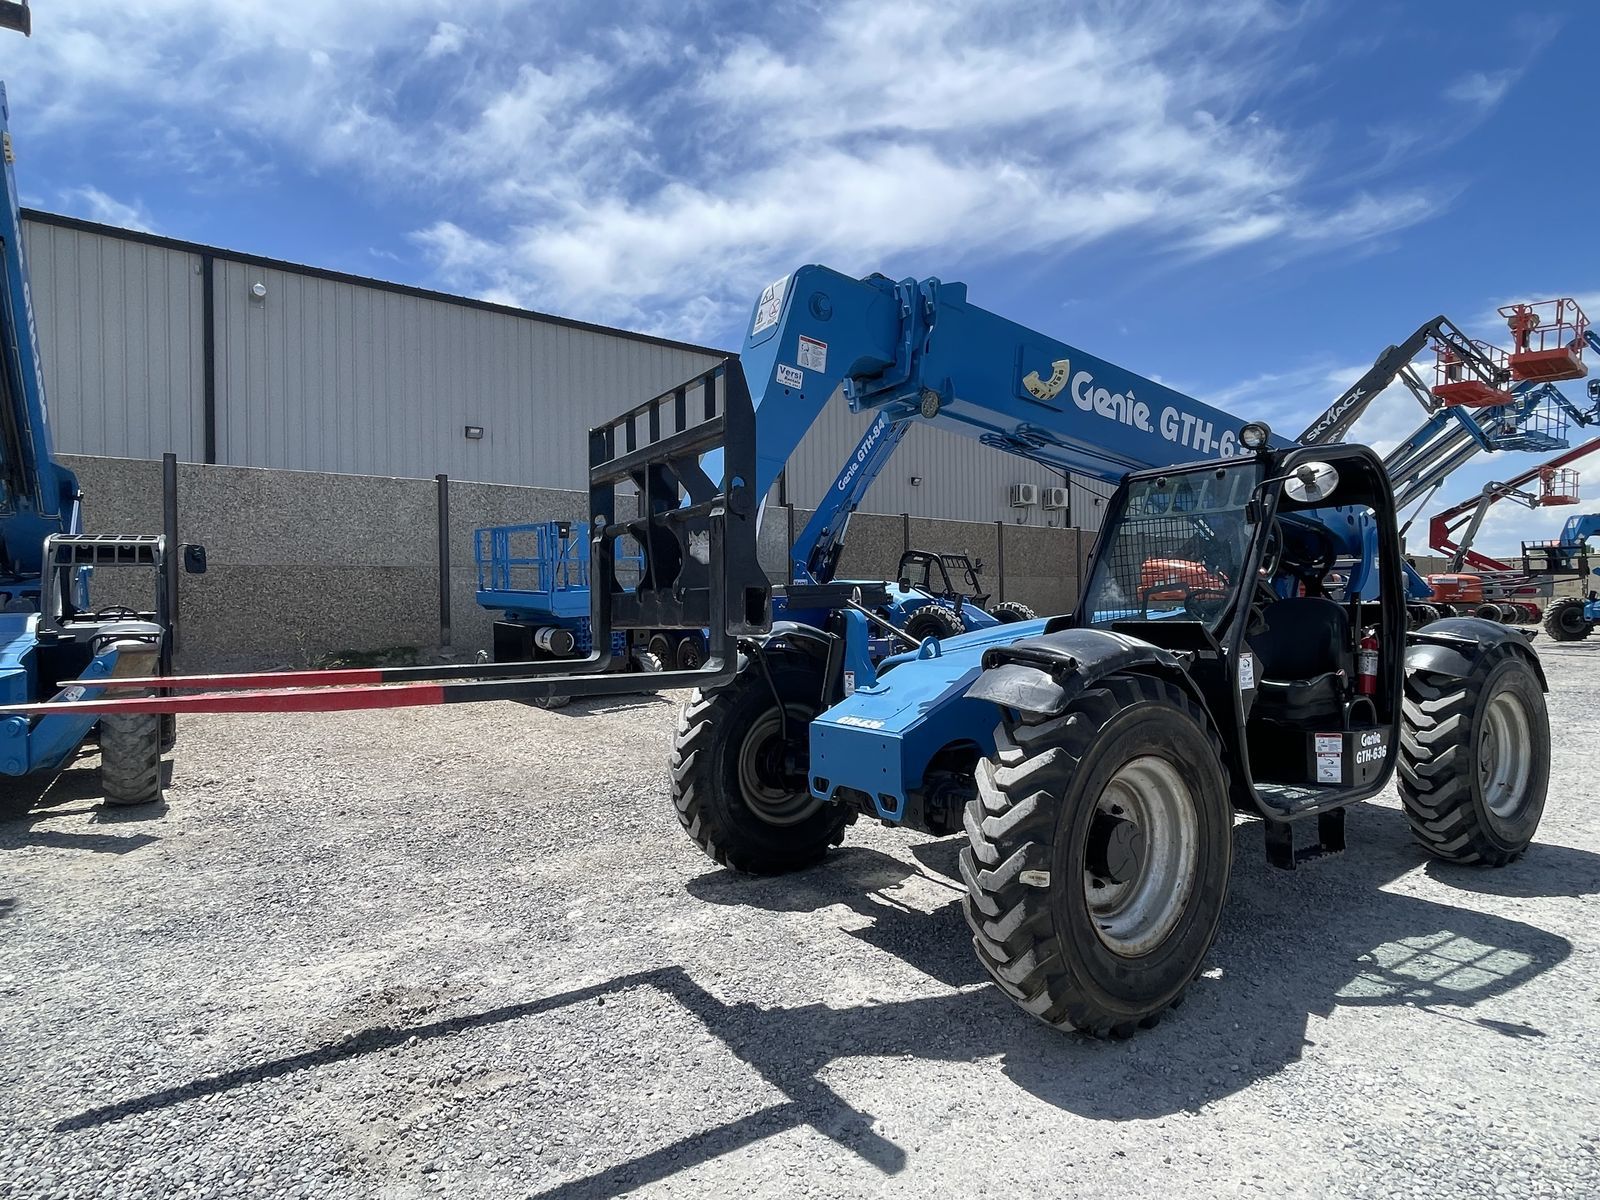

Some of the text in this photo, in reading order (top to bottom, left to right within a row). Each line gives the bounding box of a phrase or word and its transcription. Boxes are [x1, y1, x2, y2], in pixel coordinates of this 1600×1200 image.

[779, 365, 802, 380] Versi
[1306, 387, 1367, 442] SKYJACK
[1160, 406, 1258, 459] GTH-6
[837, 462, 860, 491] Genie
[1361, 731, 1381, 747] Genie
[1356, 745, 1387, 764] GTH-636
